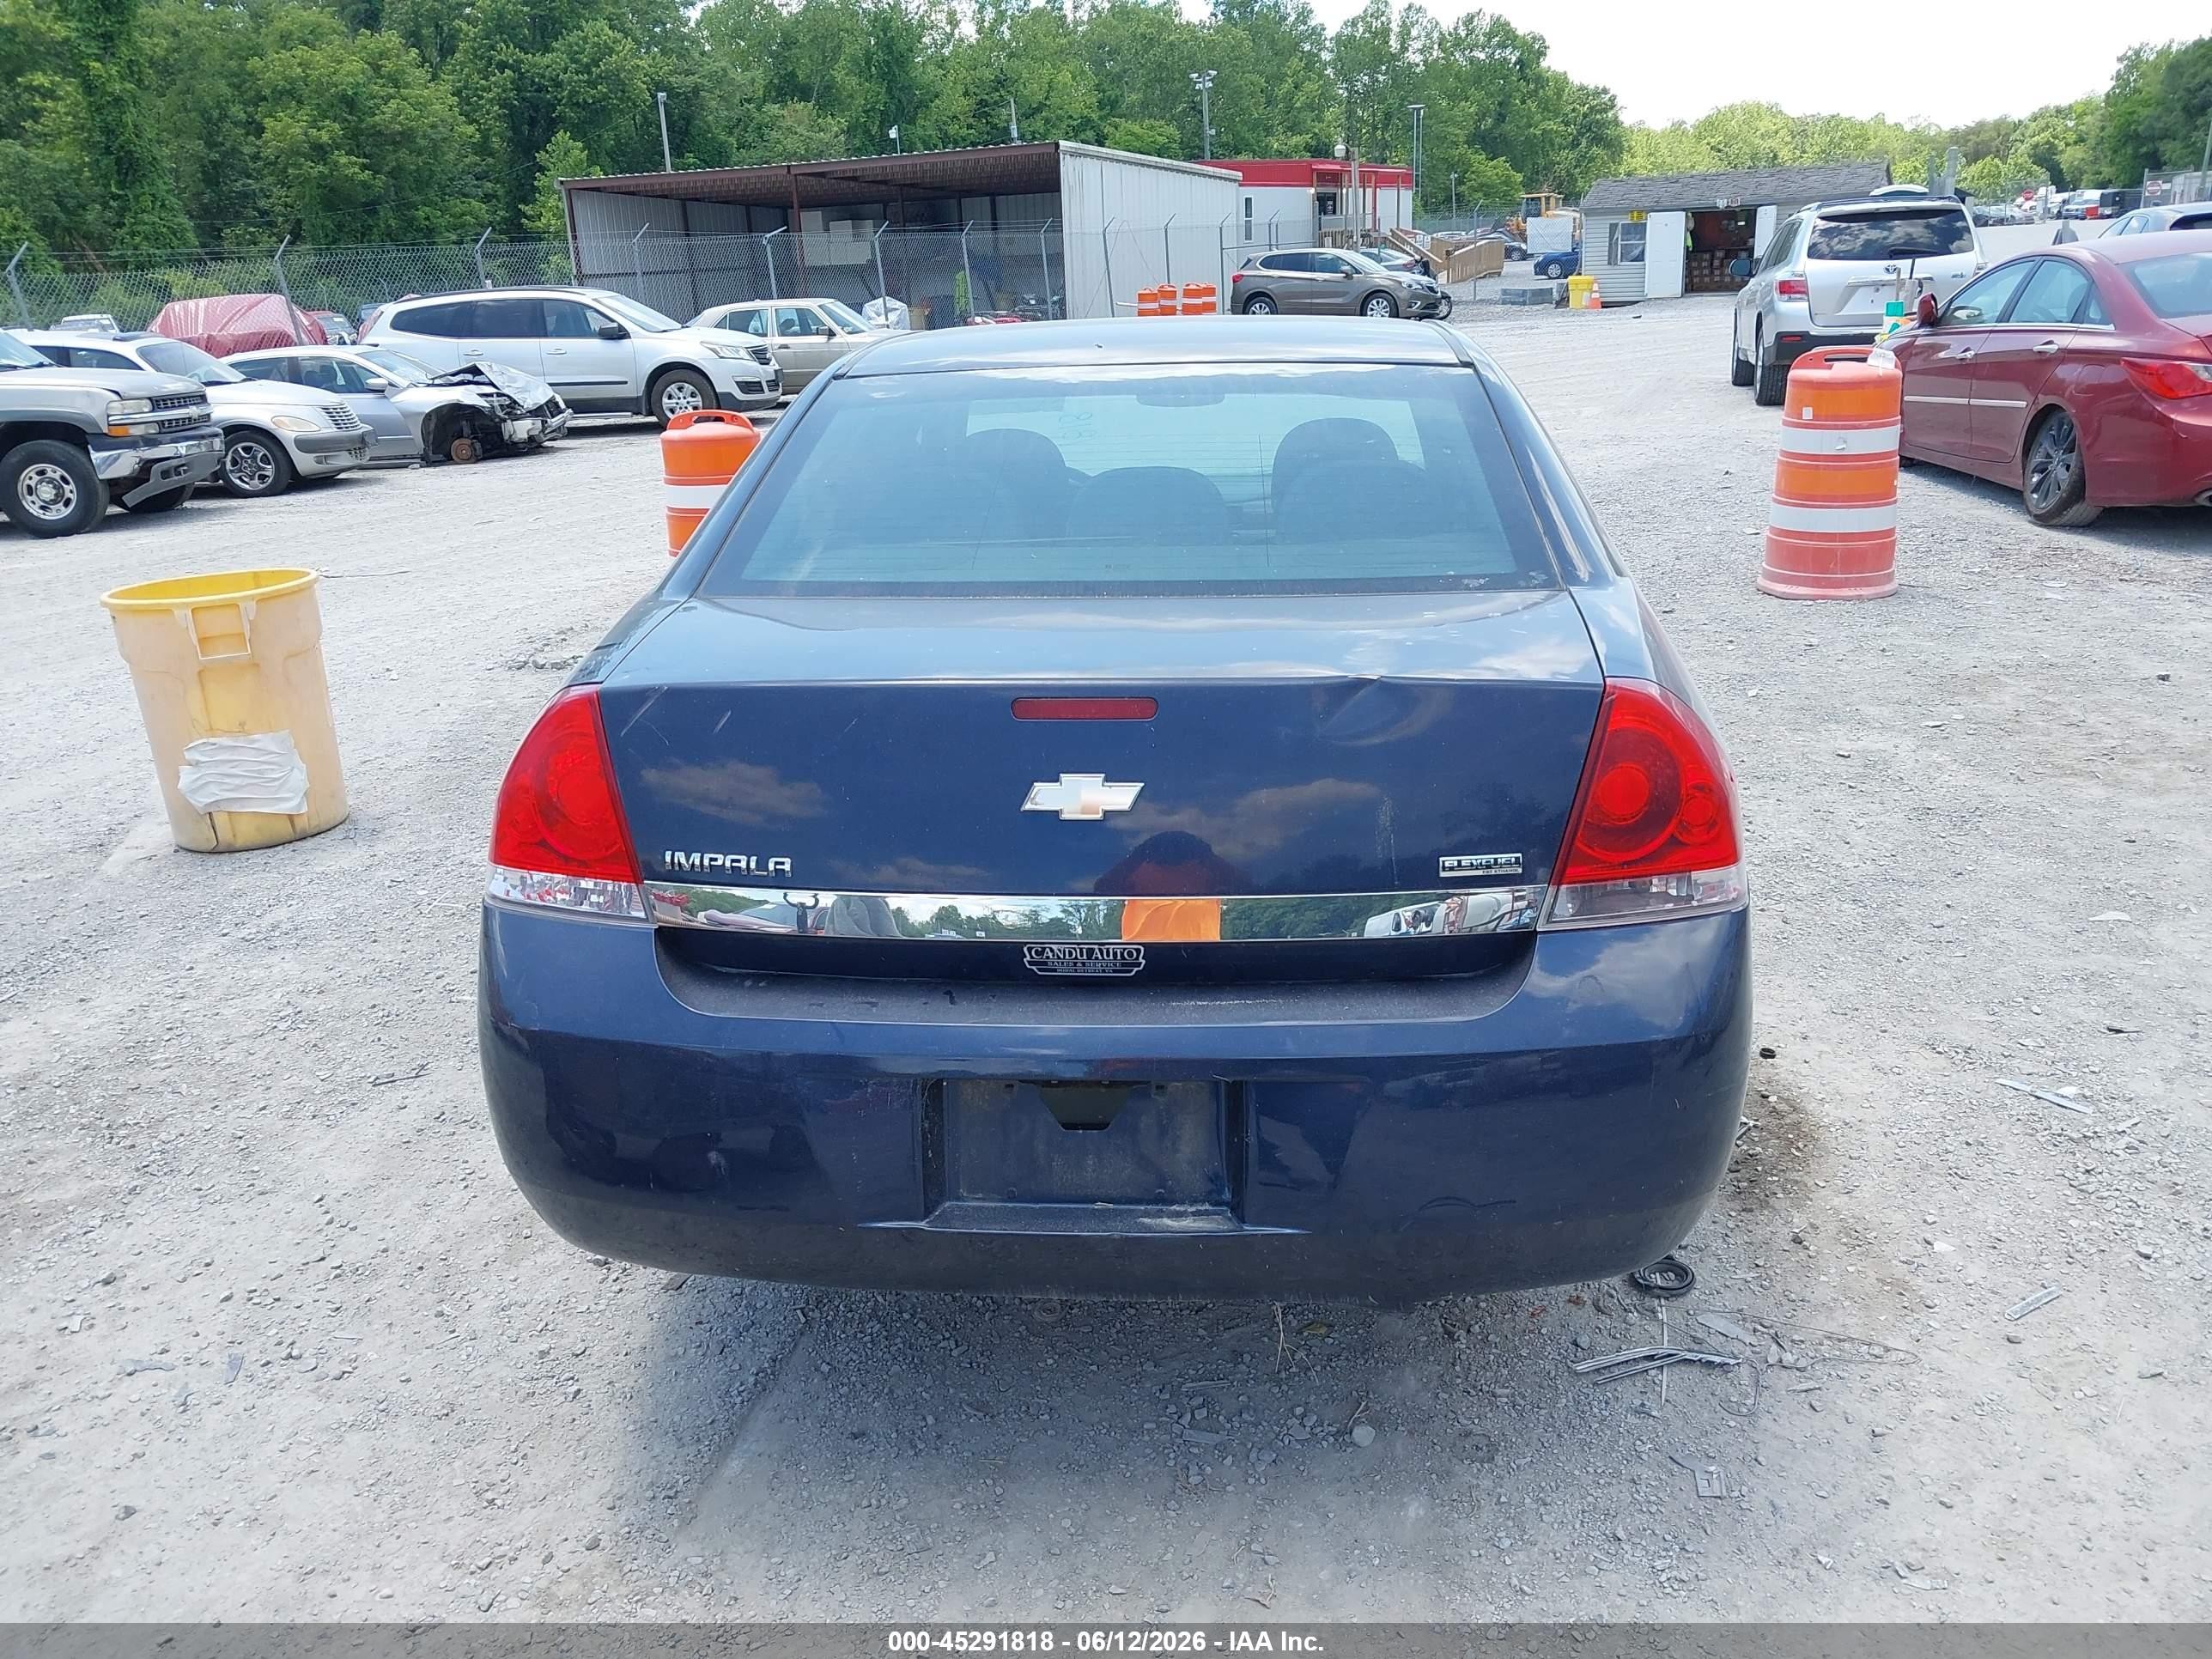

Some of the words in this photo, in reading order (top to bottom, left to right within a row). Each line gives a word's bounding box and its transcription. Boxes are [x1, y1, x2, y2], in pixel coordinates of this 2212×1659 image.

[665, 850, 792, 878] IMPALA
[1030, 946, 1087, 959] CANDU
[1091, 948, 1137, 960] AUTO
